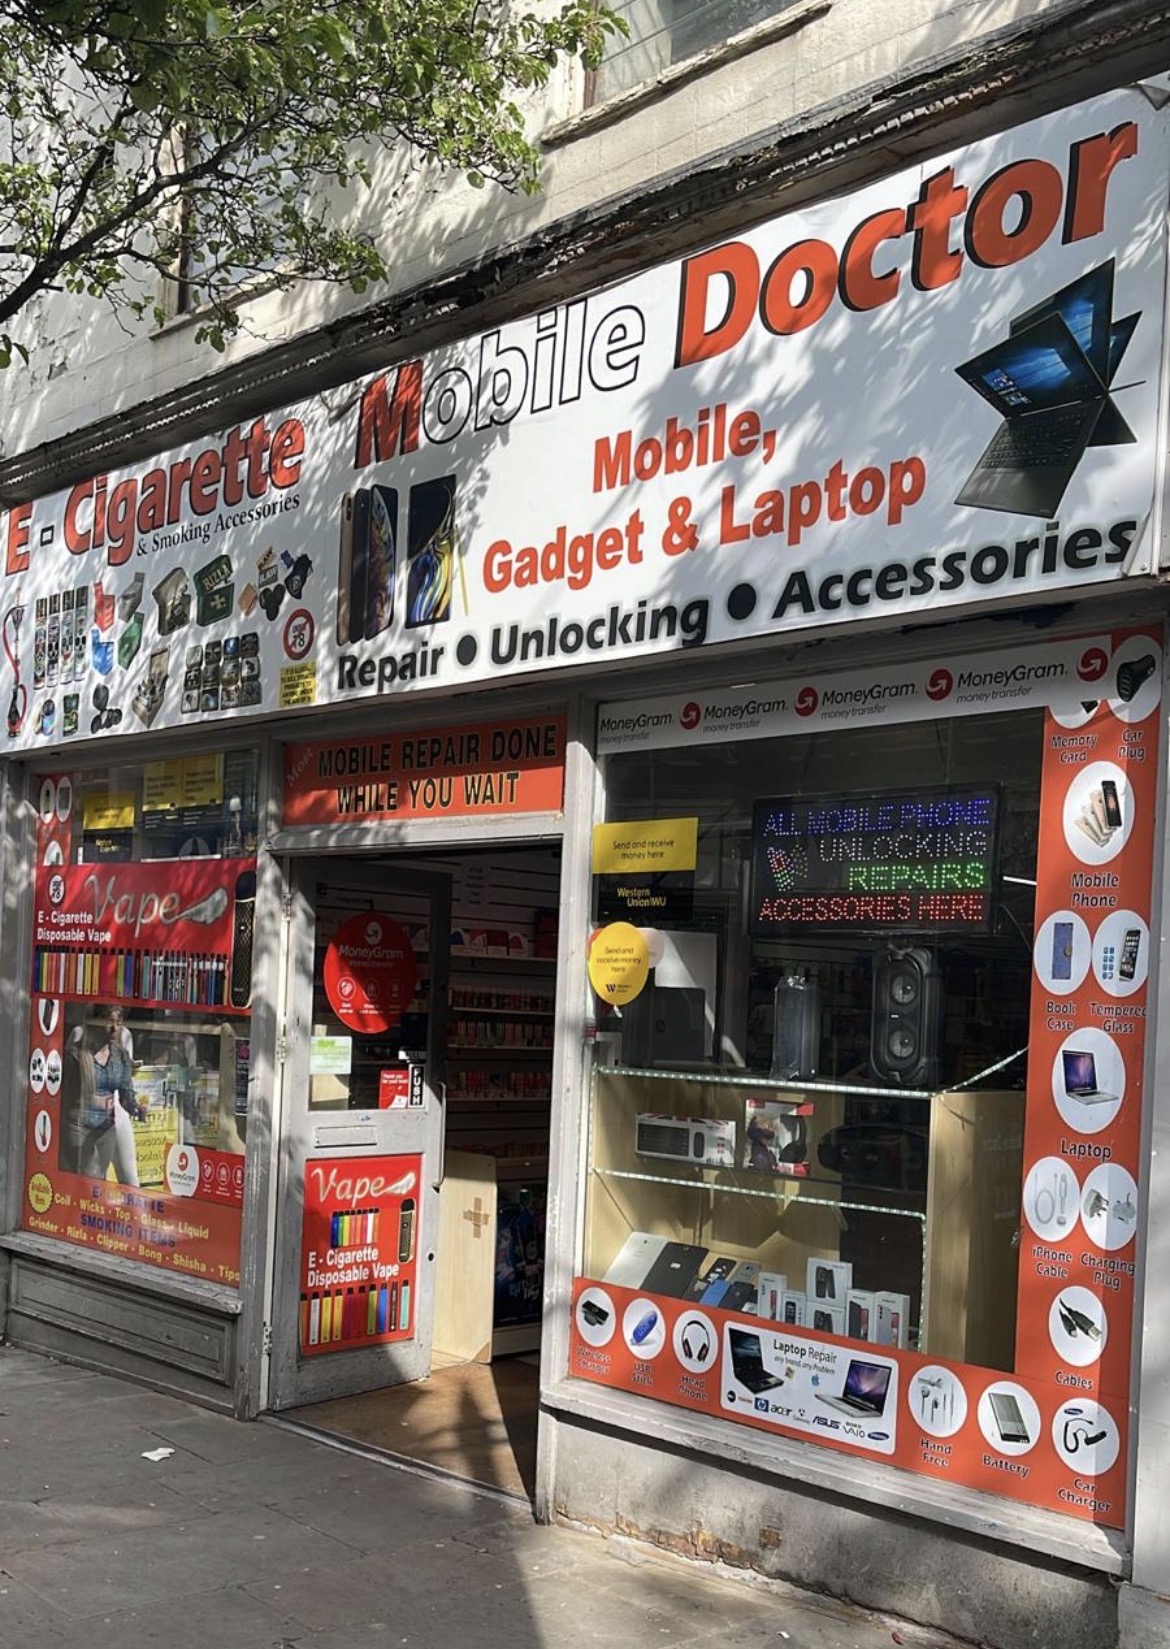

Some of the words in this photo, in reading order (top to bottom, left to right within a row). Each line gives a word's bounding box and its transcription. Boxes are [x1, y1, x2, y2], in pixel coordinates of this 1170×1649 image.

[354, 298, 646, 469] Mobile
[674, 121, 1137, 369] Doctor
[593, 403, 777, 493] Mobile,
[5, 503, 33, 576] E
[64, 417, 305, 566] Cigarette
[137, 537, 148, 557] &
[152, 522, 211, 555] Smoking
[214, 494, 300, 531] Accessories
[483, 508, 644, 594] Gadget
[662, 497, 698, 556] &
[720, 456, 926, 547] Laptop
[203, 563, 231, 591] RIZLA
[338, 641, 444, 694] Repair
[491, 600, 709, 667] Unlocking
[771, 520, 1137, 619] Accessories
[957, 664, 1065, 690] MoneyGram
[822, 681, 915, 709] MoneyGram
[956, 690, 991, 704] money
[991, 685, 1032, 699] transfer
[704, 699, 785, 720] MoneyGram
[821, 707, 850, 720] money
[850, 703, 887, 717] transfer
[600, 713, 672, 732] MoneyGram
[703, 723, 729, 734] money
[729, 719, 760, 732] transfer
[1051, 734, 1097, 749] Memory
[1122, 728, 1143, 743] Car
[319, 743, 391, 778] MOBILE
[402, 733, 480, 771] REPAIR
[491, 724, 557, 763] DONE
[1060, 750, 1087, 763] Card
[1118, 746, 1145, 763] Plug
[338, 781, 398, 814] WHILE
[409, 776, 452, 809] YOU
[464, 772, 520, 806] WAIT
[763, 812, 802, 837] ALL
[808, 805, 893, 835] MOBILE
[900, 799, 990, 829] PHONE
[613, 841, 631, 850] Send
[631, 840, 647, 848] and
[647, 838, 676, 848] receive
[820, 831, 987, 862] UNLOCKING
[621, 852, 646, 860] money
[849, 862, 985, 891] REPAIRS
[1071, 873, 1119, 888] Mobile
[617, 887, 651, 898] Western
[1071, 893, 1117, 907] Phone
[84, 873, 187, 939] Vape
[759, 895, 911, 921] ACCESSORIES
[918, 894, 983, 921] HERE
[37, 911, 44, 923] E
[51, 911, 93, 927] Cigarette
[37, 928, 85, 943] Disposable
[87, 928, 112, 943] Vape
[338, 944, 404, 959] MoneyGram
[1047, 1017, 1074, 1030] Case
[1103, 1019, 1134, 1033] Glass
[411, 1068, 422, 1106] PUSH
[1061, 1140, 1111, 1161] Laptop
[310, 1168, 387, 1208] Vape
[54, 1193, 71, 1206] Coil
[80, 1199, 105, 1215] Wicks
[115, 1207, 131, 1222] Top
[141, 1214, 168, 1229] Glass
[178, 1222, 209, 1240] Liquid
[80, 1214, 133, 1237] SMOKING
[138, 1228, 176, 1248] ITEMS
[29, 1216, 58, 1232] Grinder
[67, 1226, 87, 1241] Rizla
[97, 1234, 128, 1252] Clipper
[138, 1245, 162, 1263] Bong
[172, 1254, 206, 1272] Shisha
[308, 1251, 316, 1268] E
[326, 1246, 378, 1268] Cigarette
[1032, 1246, 1072, 1263] iPhone
[1036, 1263, 1067, 1278] Cable
[1081, 1253, 1135, 1276] Charging
[308, 1265, 369, 1288] Disposable
[372, 1263, 400, 1281] Vape
[1093, 1271, 1121, 1290] Plug
[773, 1339, 807, 1359] Laptop
[808, 1347, 838, 1364] Repair
[634, 1363, 652, 1374] USB
[682, 1375, 706, 1389] Head
[1056, 1371, 1093, 1390] Cables
[771, 1404, 793, 1417] acer
[812, 1416, 842, 1430] ASUS
[842, 1425, 866, 1439] VAIO
[921, 1438, 952, 1455] Hand
[923, 1452, 948, 1467] Free
[983, 1455, 1029, 1479] Battery
[1074, 1478, 1097, 1493] Car
[1057, 1489, 1112, 1513] Charger
